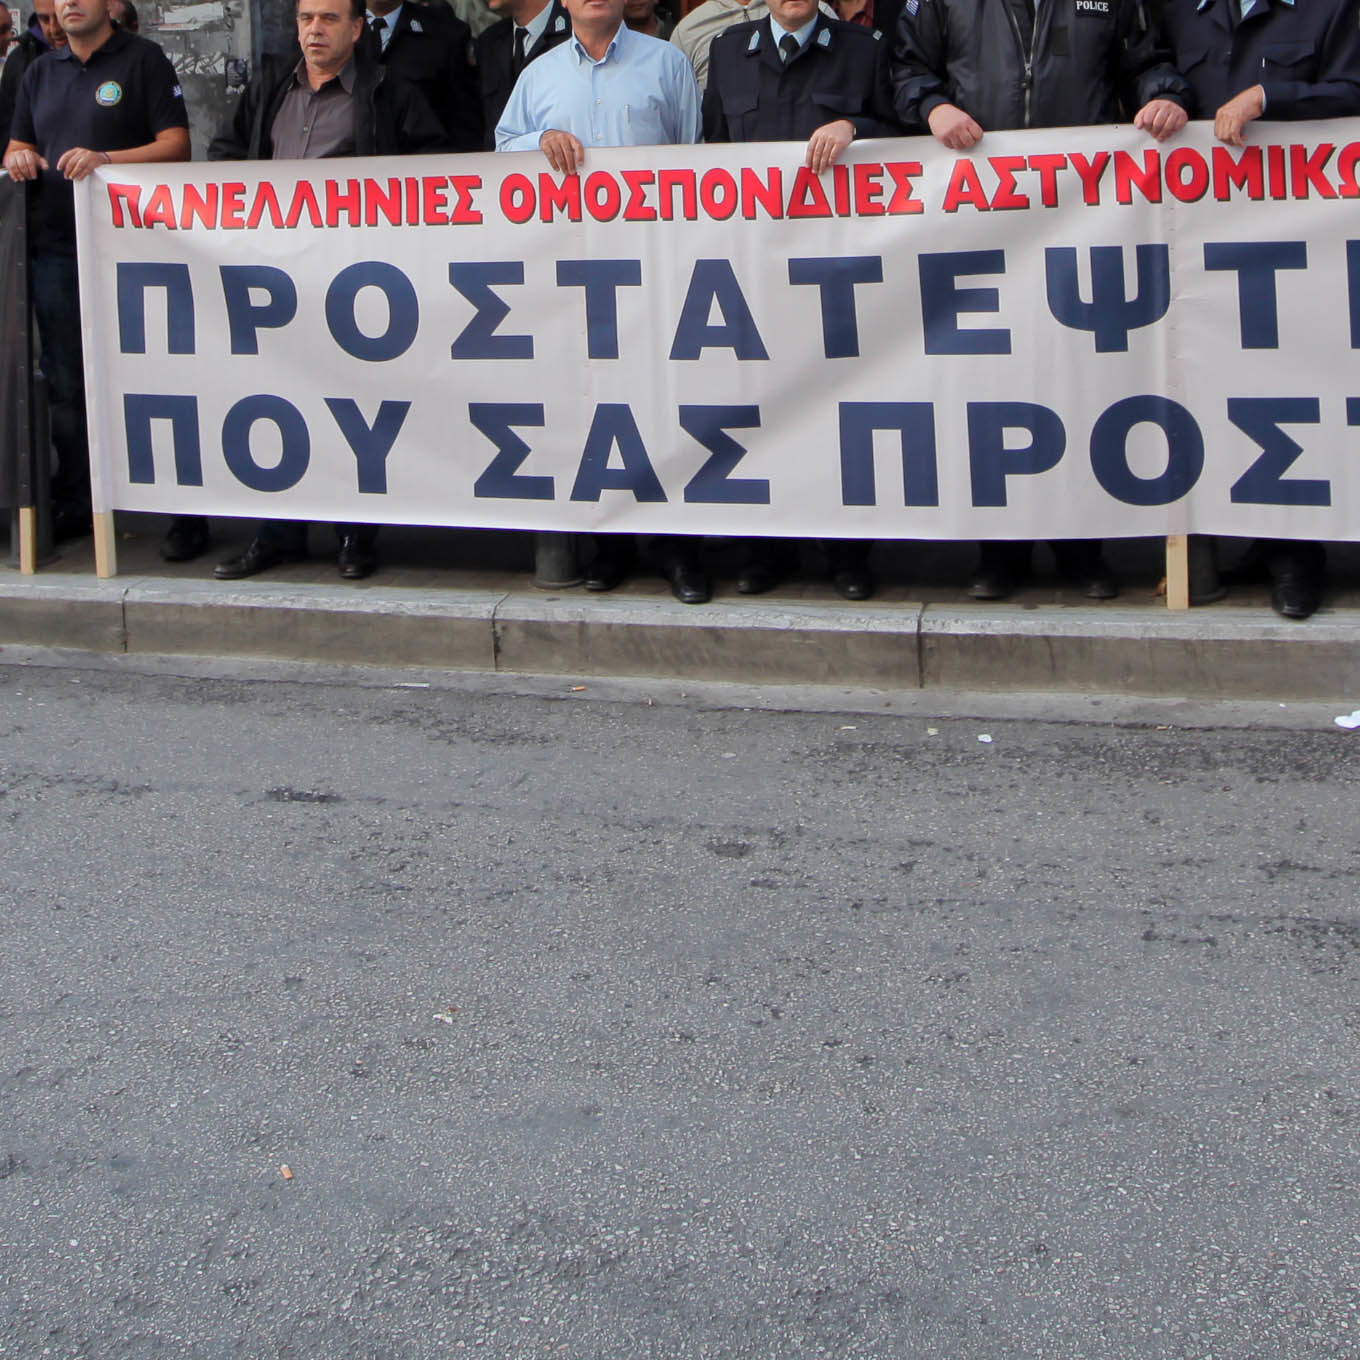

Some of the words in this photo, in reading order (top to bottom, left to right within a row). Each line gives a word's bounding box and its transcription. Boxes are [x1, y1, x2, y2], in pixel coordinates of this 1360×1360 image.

[1076, 0, 1109, 12] POLICE
[107, 173, 483, 229] ΠΑΝΕΛΛΗΝΙΕΣ
[499, 161, 925, 223] ΟΜΟΣΠΟΝΔΙΕΣ
[123, 393, 412, 495] ΠΟΥ
[468, 402, 771, 505] ΣΑΣ
